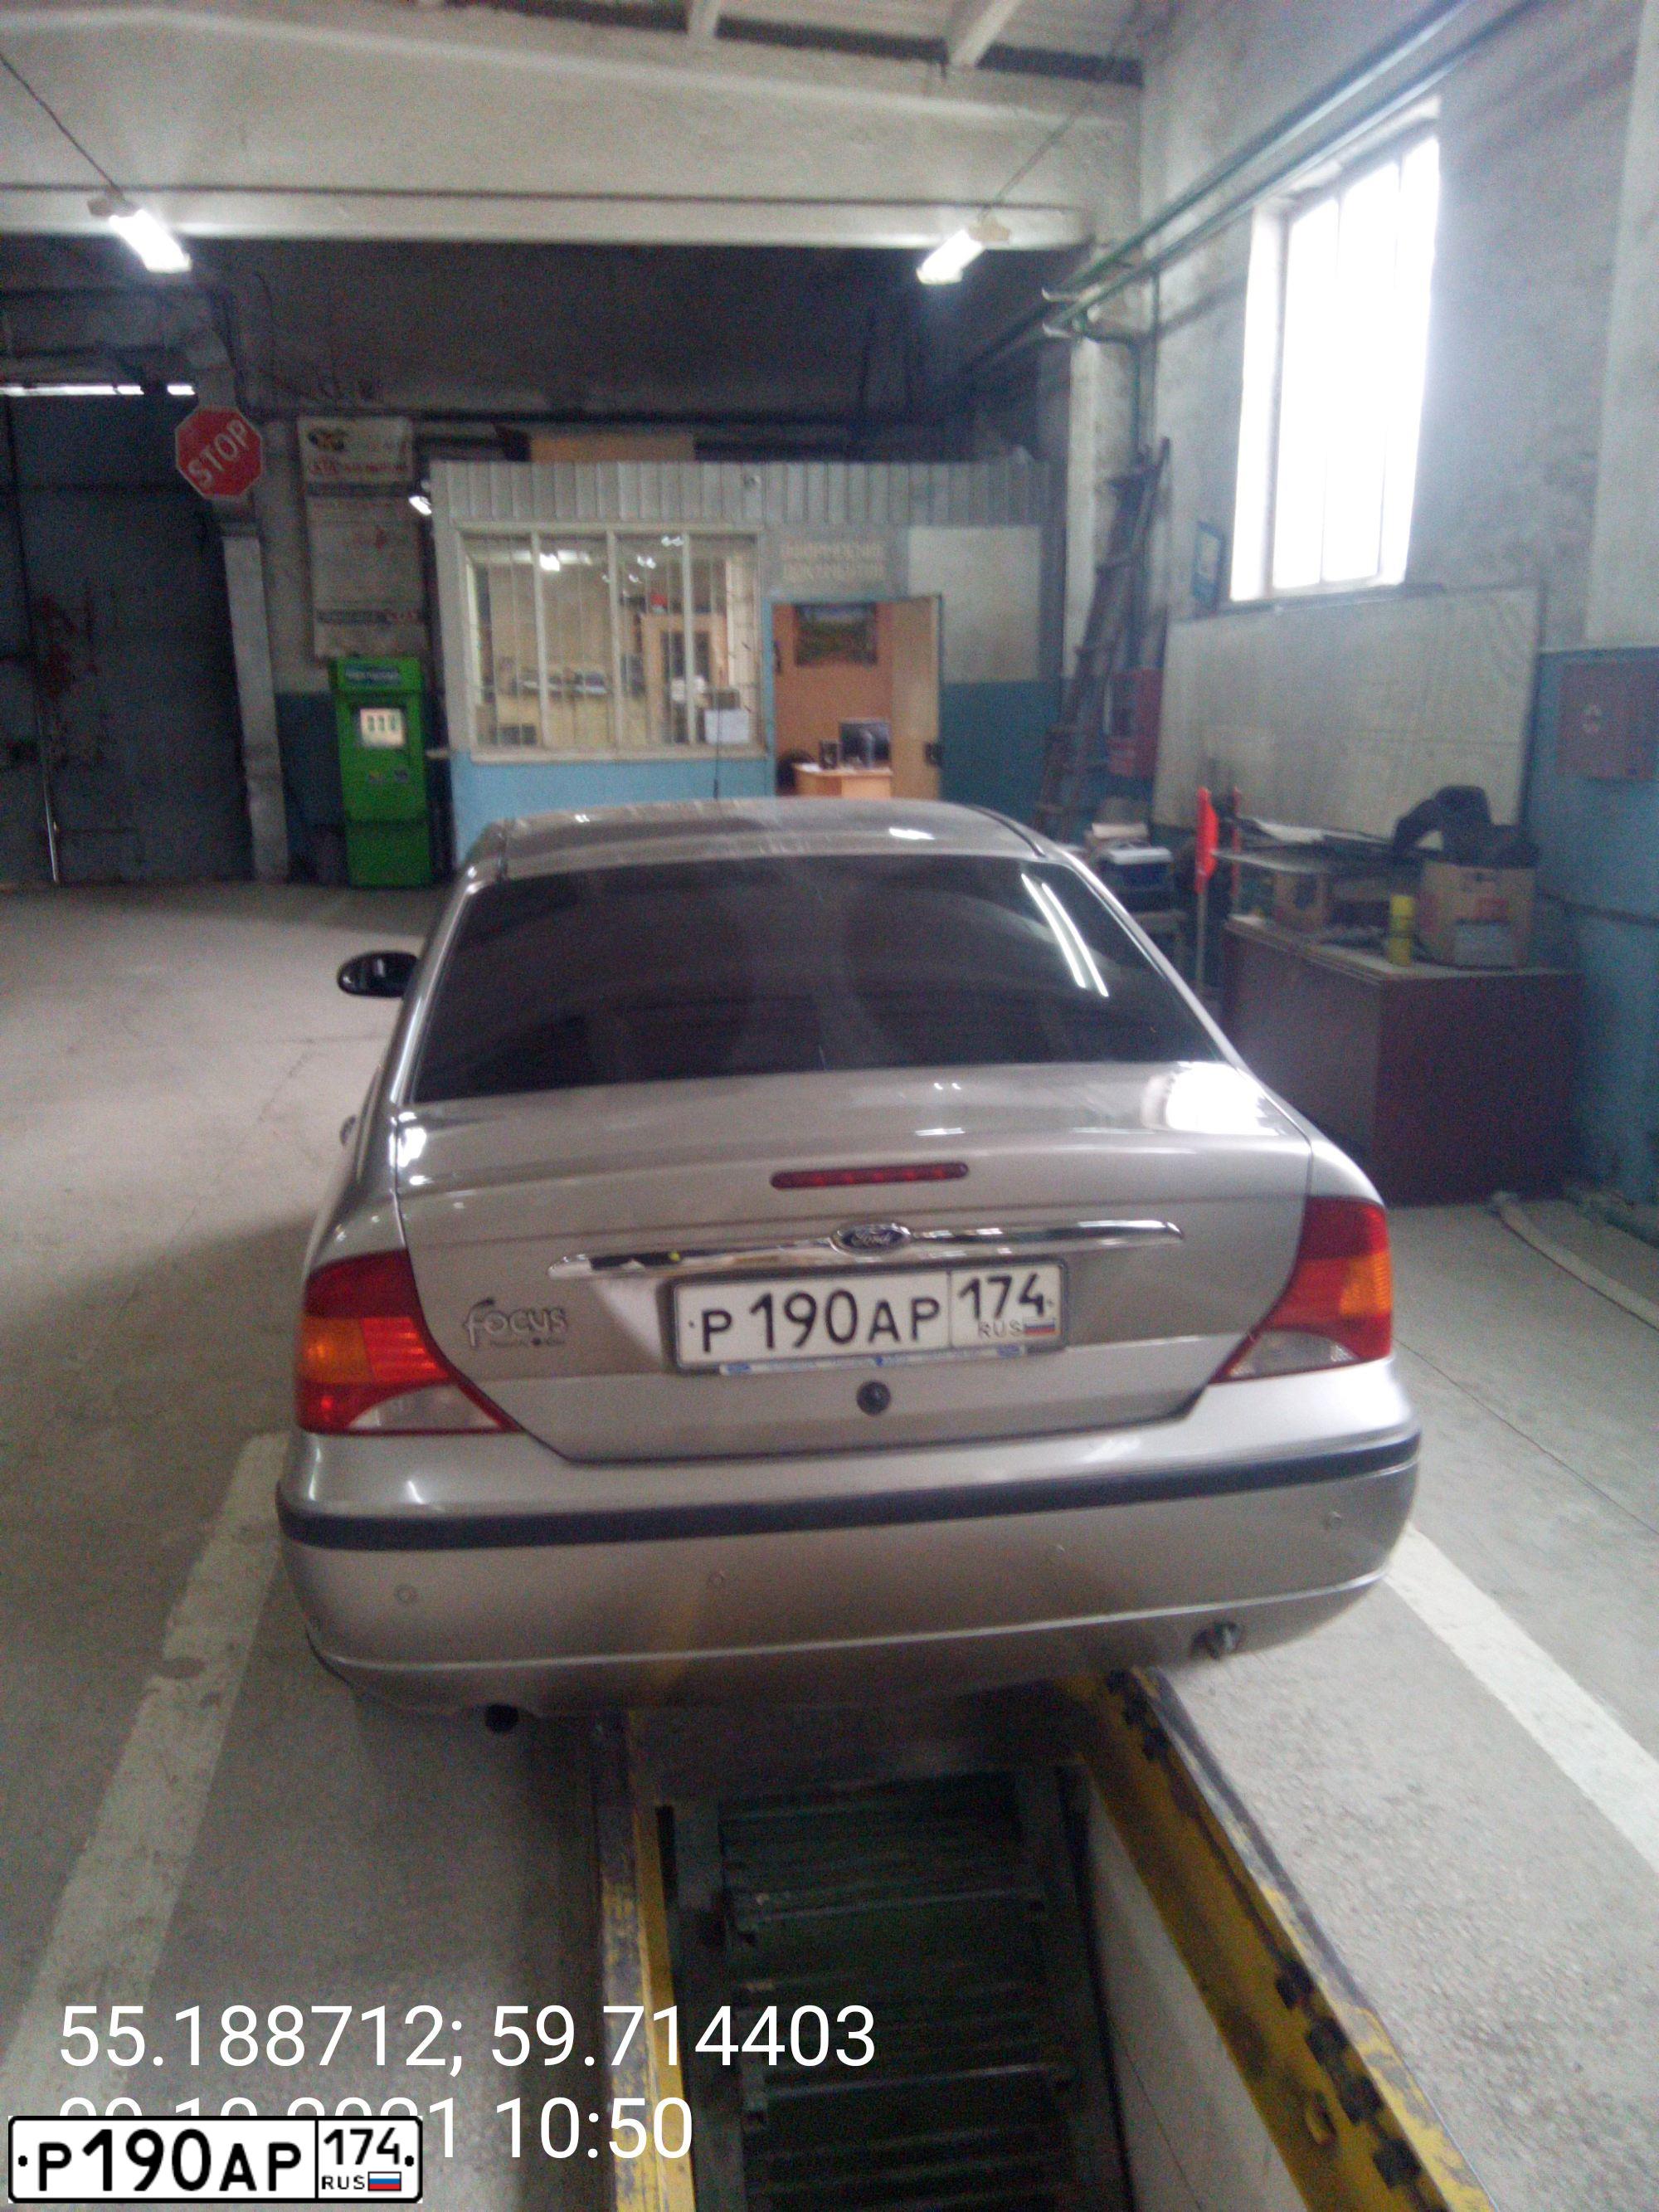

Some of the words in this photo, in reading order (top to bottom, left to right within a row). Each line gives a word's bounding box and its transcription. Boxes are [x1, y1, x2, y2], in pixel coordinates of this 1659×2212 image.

[187, 419, 250, 488] STOP
[957, 1272, 1045, 1320] 174
[977, 1318, 1023, 1338] RUS
